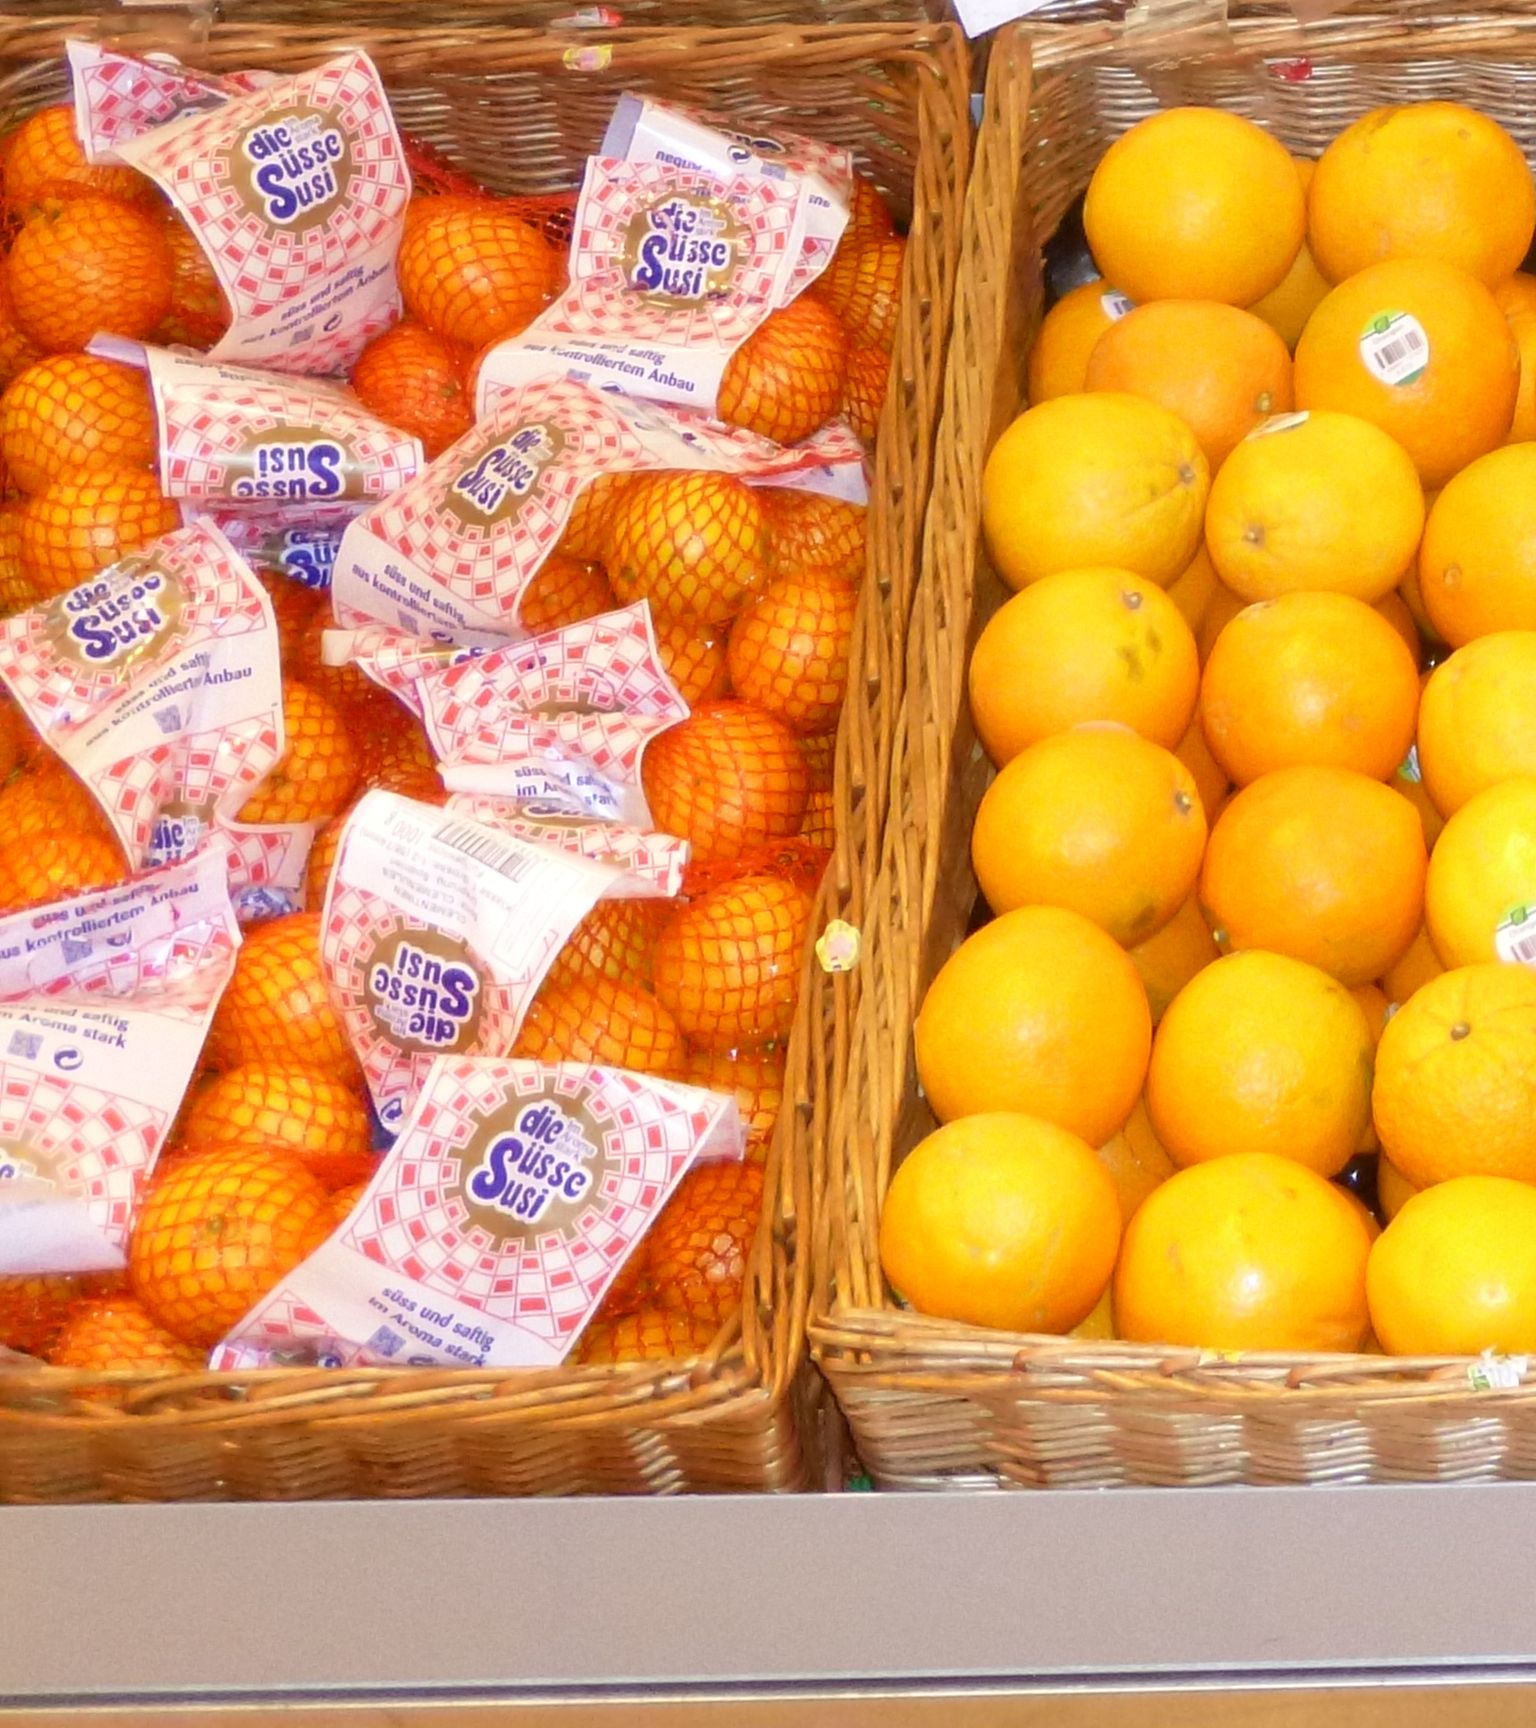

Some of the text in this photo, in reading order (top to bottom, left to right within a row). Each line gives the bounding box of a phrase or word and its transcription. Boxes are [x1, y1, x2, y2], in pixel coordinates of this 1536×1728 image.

[247, 124, 292, 160] die
[256, 133, 341, 220] Süsse
[256, 163, 335, 220] Susi
[650, 202, 697, 231] die
[636, 235, 728, 293] Süsse
[310, 282, 332, 304] und
[627, 346, 667, 366] saftig
[647, 367, 696, 393] Anbau
[514, 426, 542, 454] die
[351, 563, 371, 584] aus
[66, 581, 111, 614] die
[384, 563, 467, 623] süss und saftig
[202, 666, 254, 687] Anbau
[149, 882, 200, 907] Anbau
[374, 966, 476, 1019] Süsse
[81, 1009, 131, 1033] saftig
[408, 1011, 457, 1043] die
[82, 1025, 128, 1050] stark
[520, 1104, 565, 1146] die
[471, 1136, 589, 1202] Süsse
[380, 1286, 496, 1353] süss und saftig
[389, 1309, 445, 1349] Aroma
